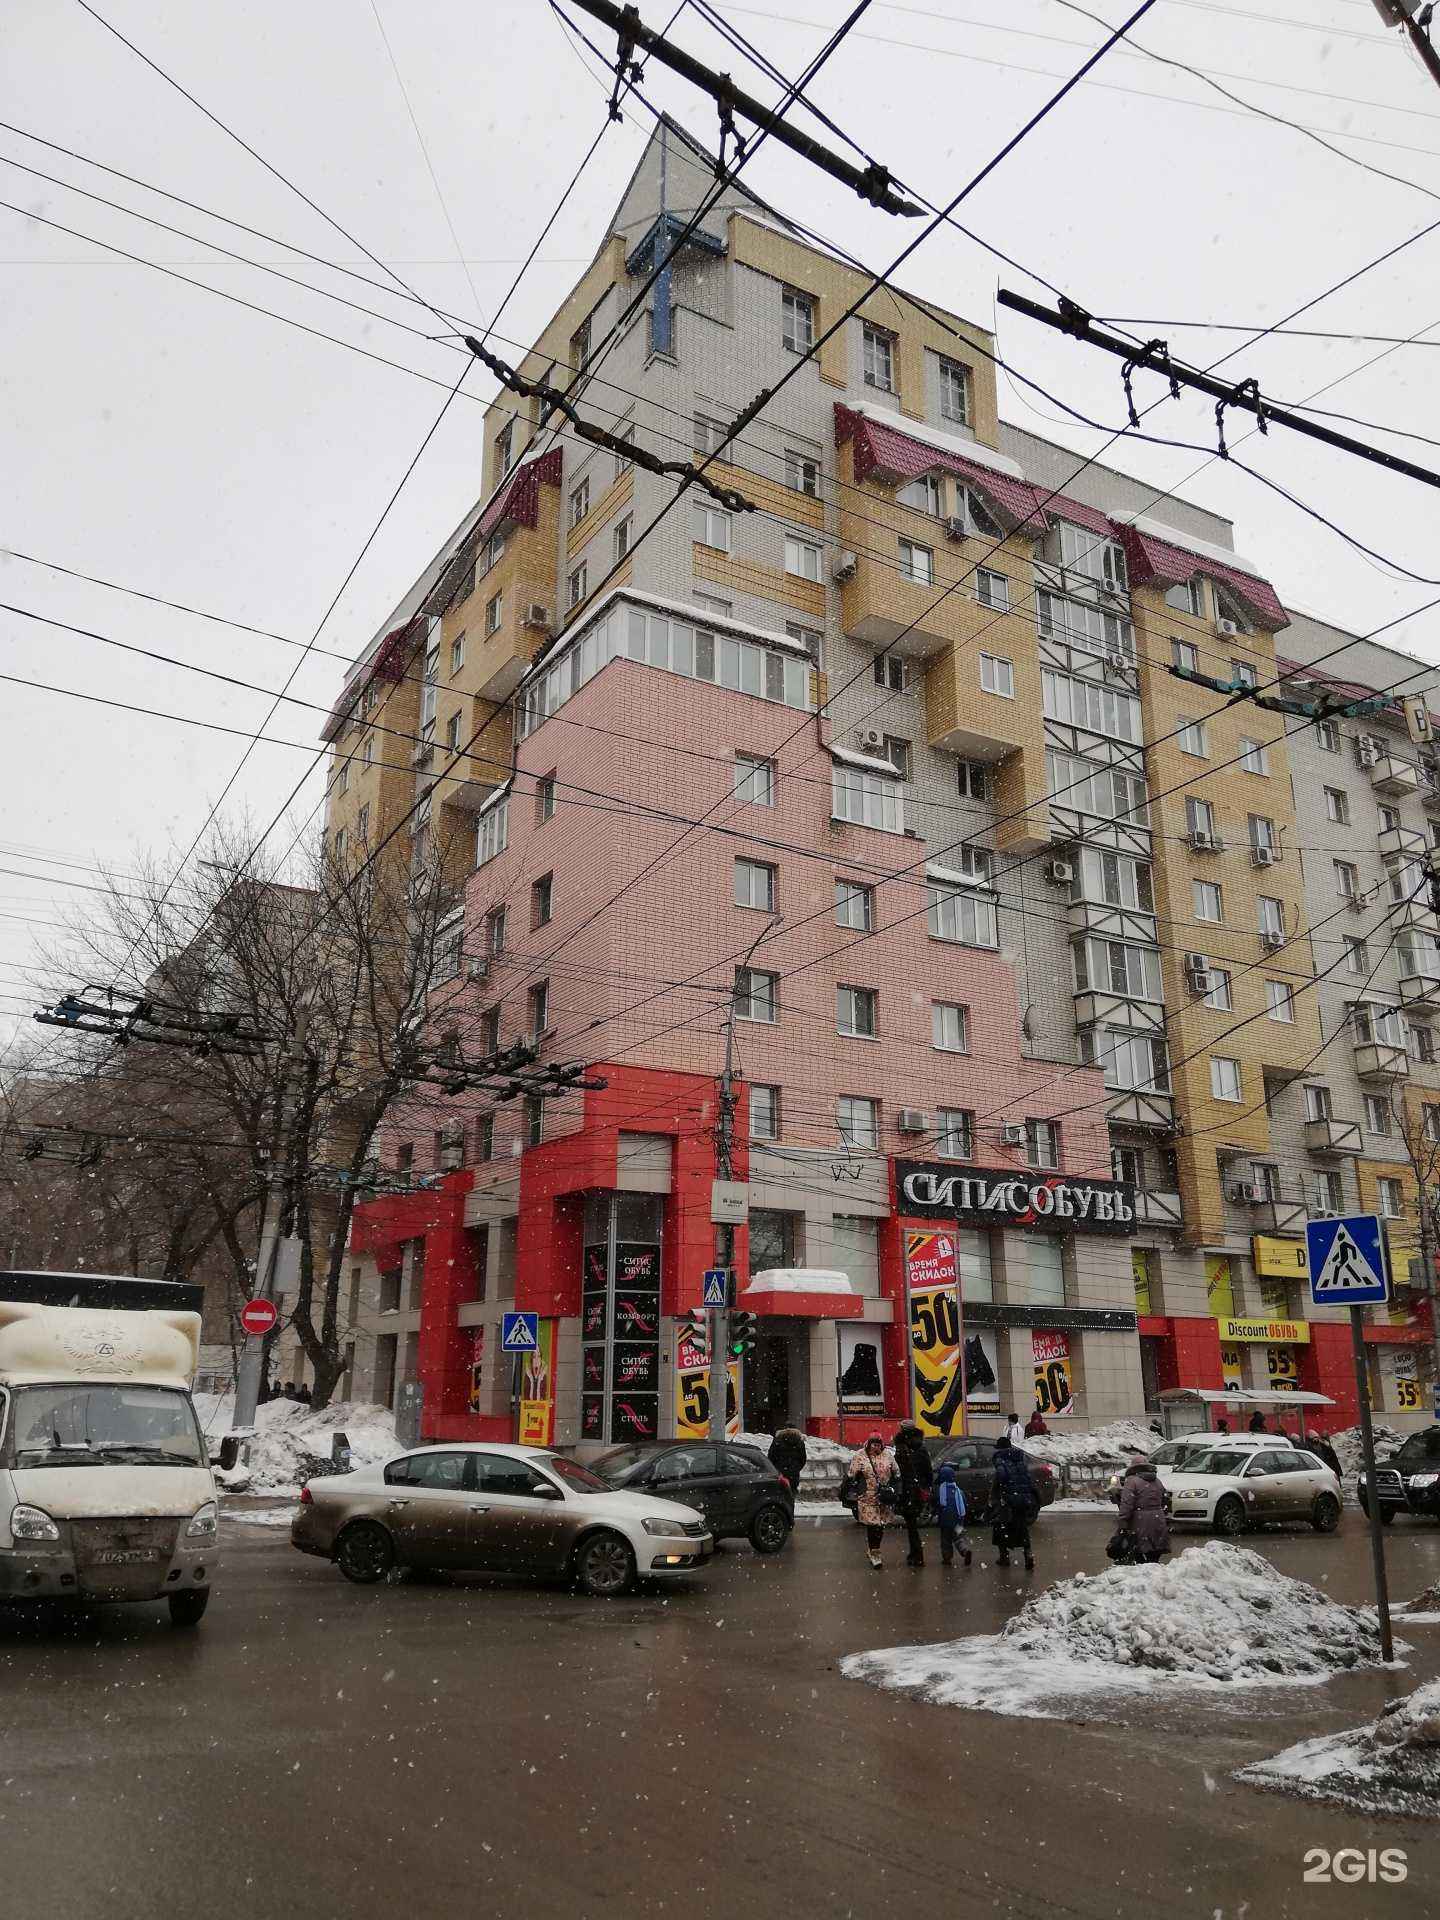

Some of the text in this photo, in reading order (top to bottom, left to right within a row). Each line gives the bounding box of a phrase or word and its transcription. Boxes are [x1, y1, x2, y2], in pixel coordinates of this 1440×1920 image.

[909, 1258, 938, 1271] ВРЕМЯ
[911, 1266, 955, 1281] СКИДОК
[617, 1312, 656, 1320] КОМФОРТ
[1228, 1321, 1298, 1339] Discount ОБУВЬ
[621, 1357, 650, 1365] СИТИС
[622, 1367, 649, 1375] ОБУВЬ
[621, 1415, 649, 1423] СТИЛЬ
